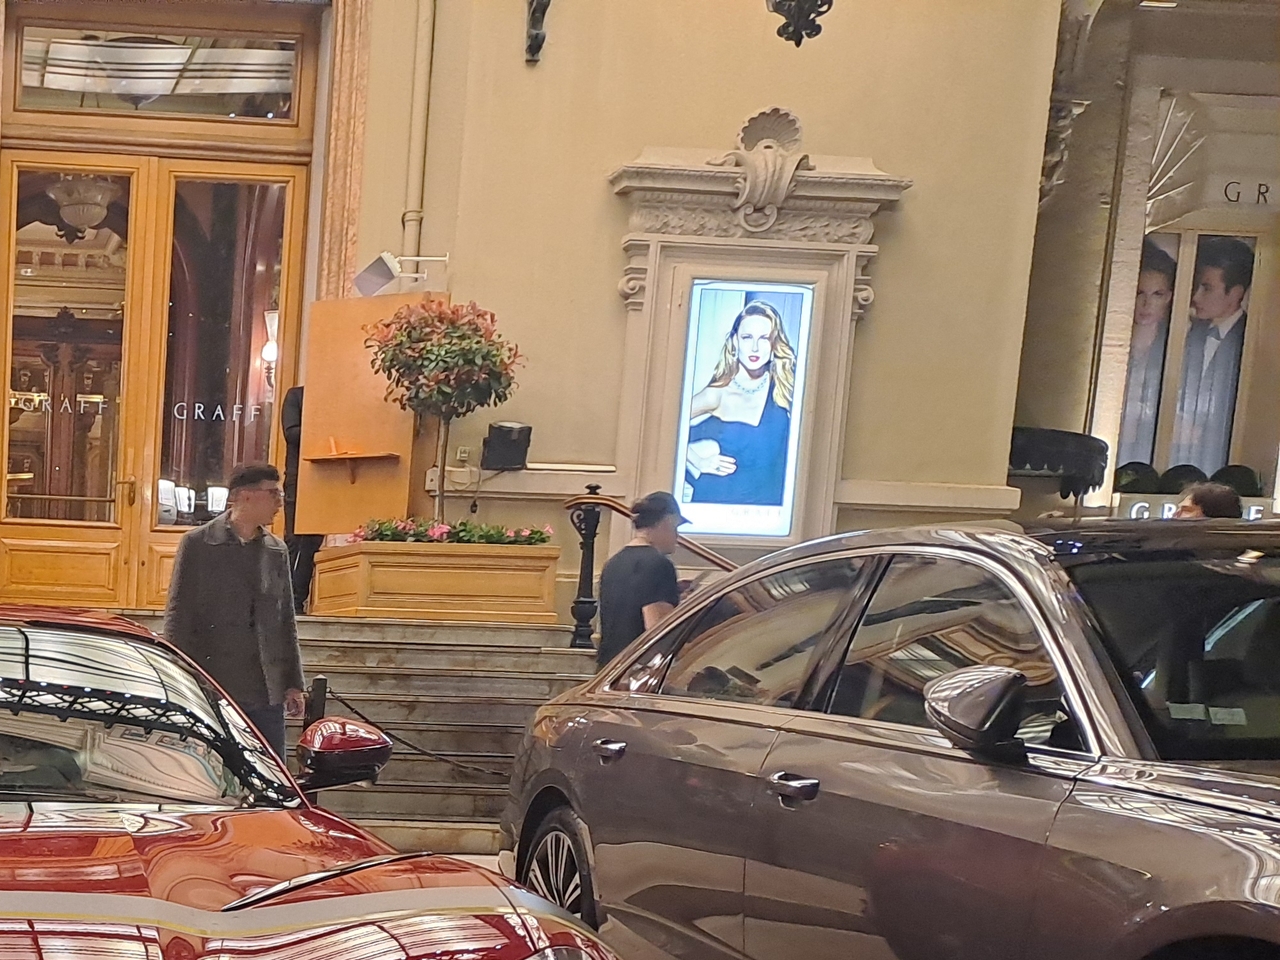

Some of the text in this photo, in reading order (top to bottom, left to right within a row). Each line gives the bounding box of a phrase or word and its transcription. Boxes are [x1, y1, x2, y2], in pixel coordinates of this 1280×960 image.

[1224, 181, 1270, 205] GR
[21, 397, 108, 415] GRAFF
[173, 402, 261, 422] GRAFF
[1130, 501, 1265, 520] GRF
